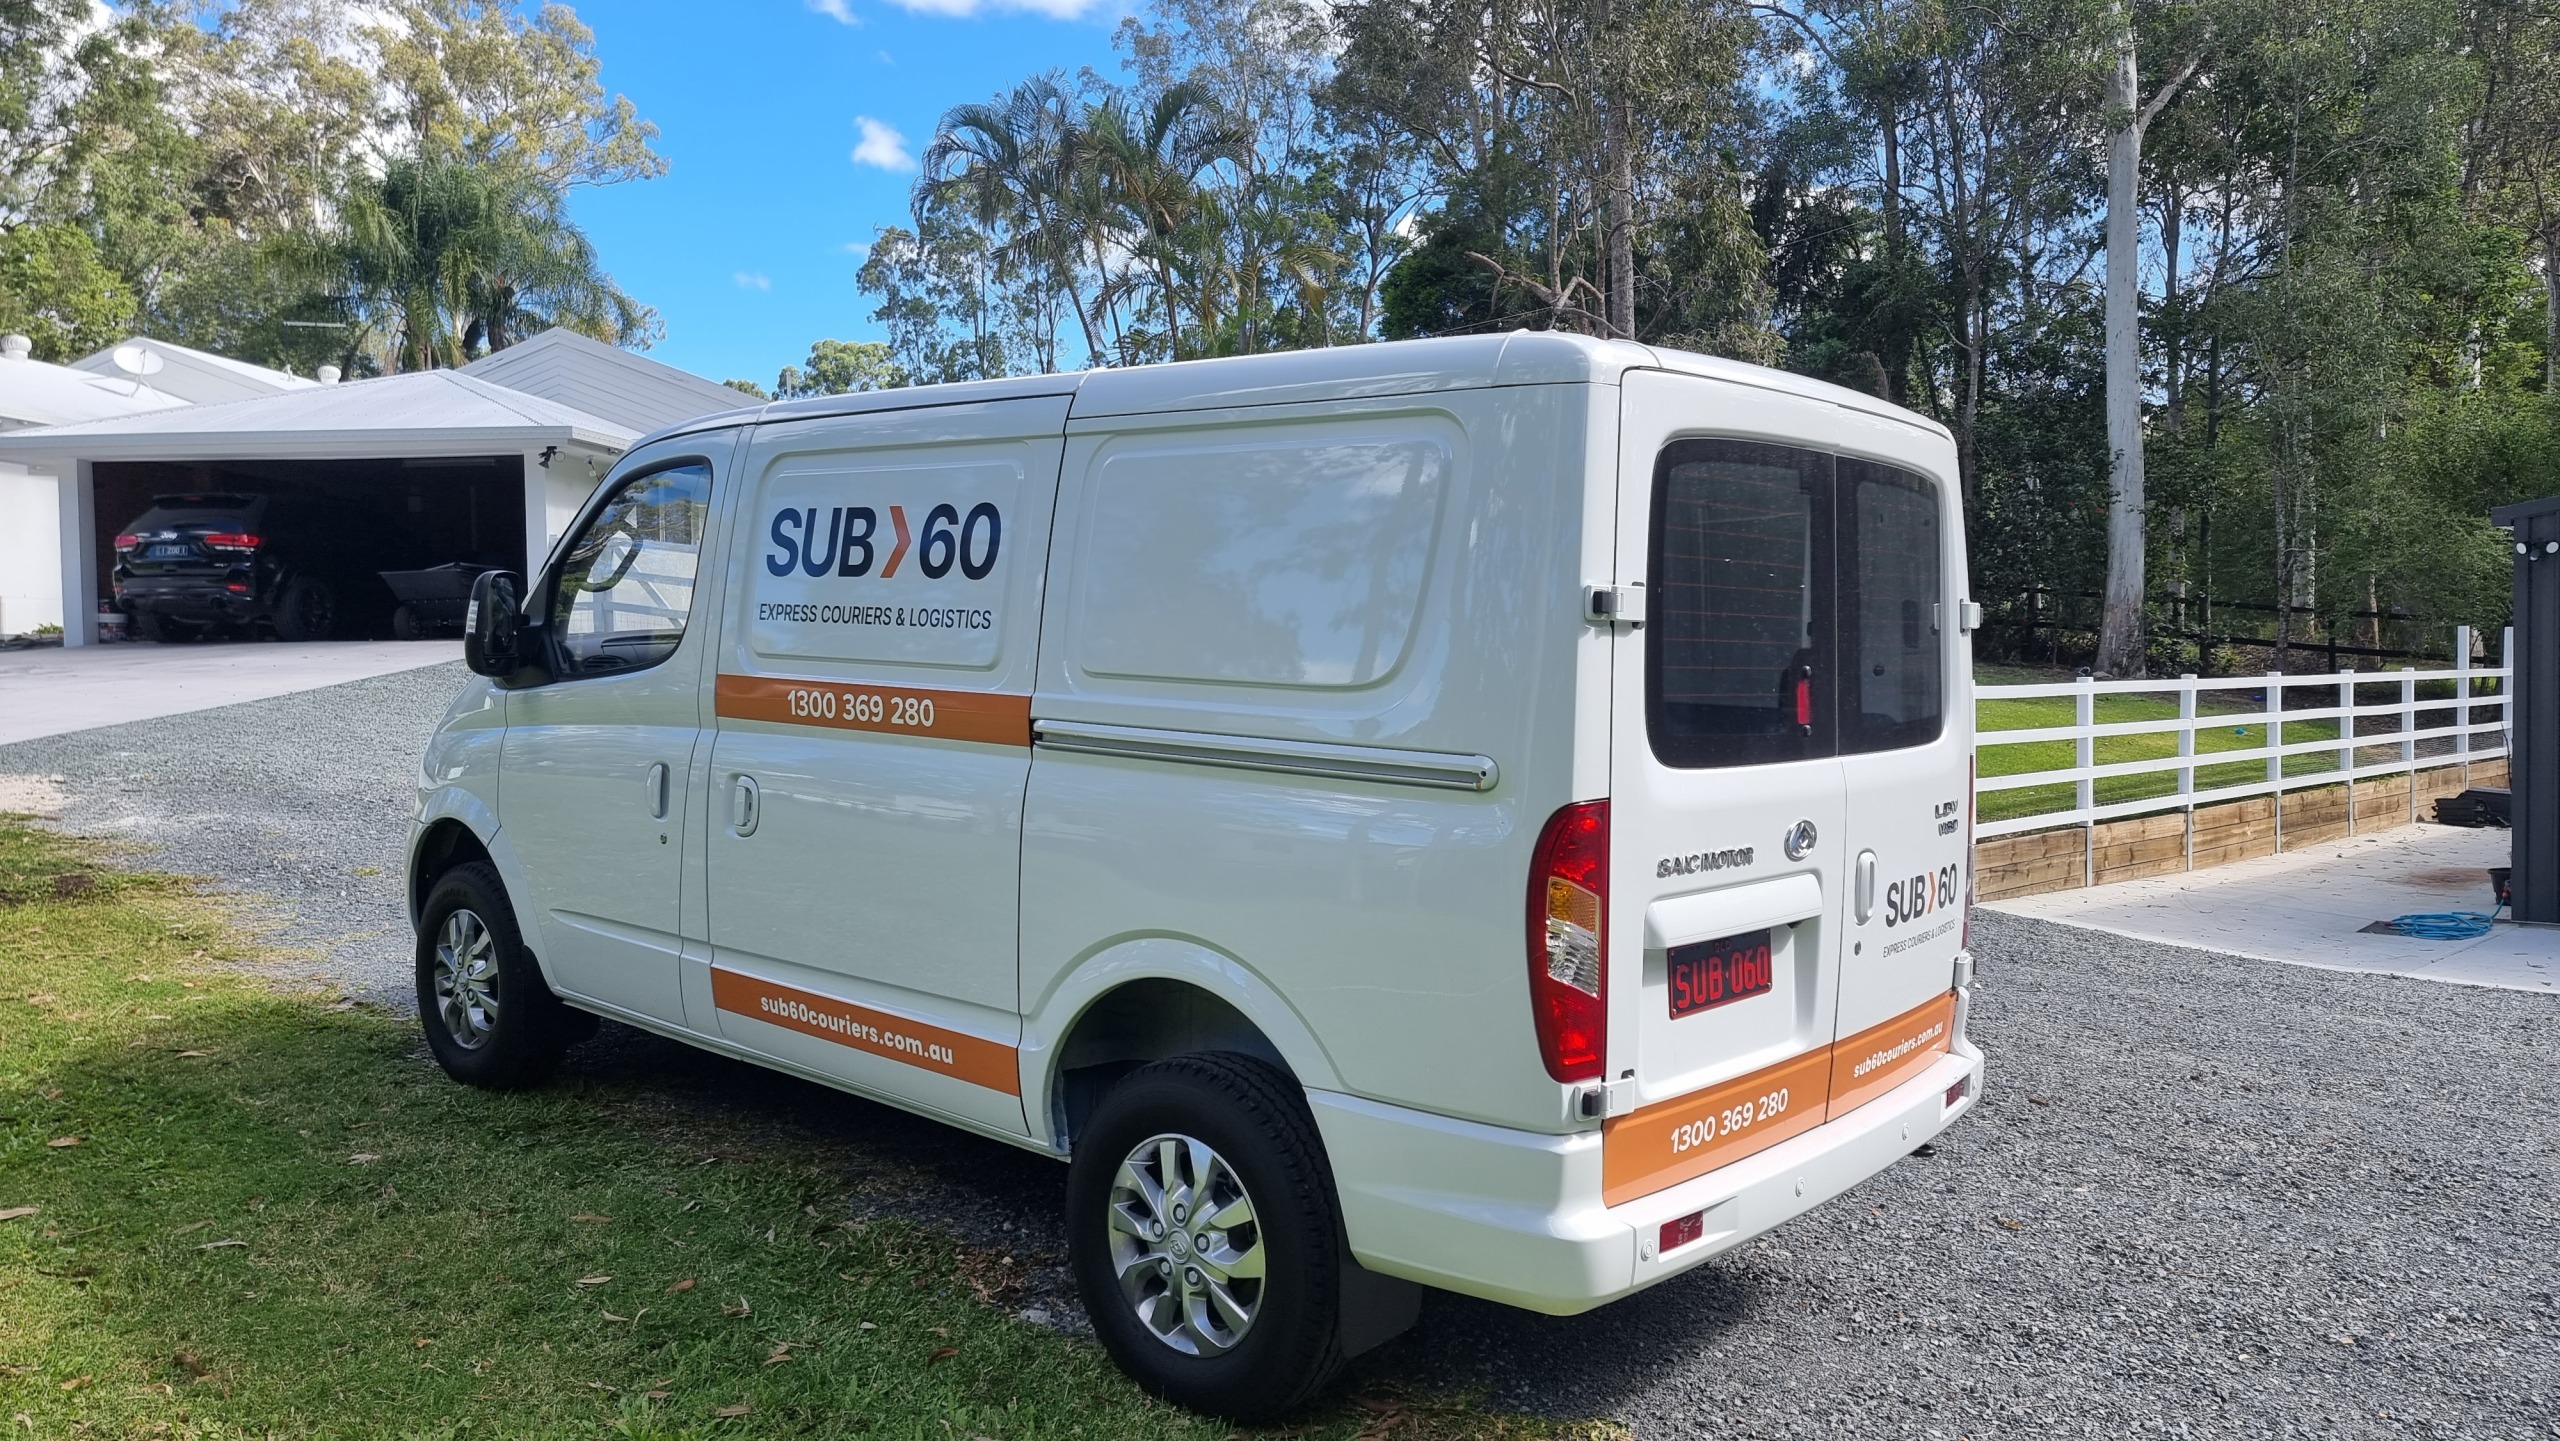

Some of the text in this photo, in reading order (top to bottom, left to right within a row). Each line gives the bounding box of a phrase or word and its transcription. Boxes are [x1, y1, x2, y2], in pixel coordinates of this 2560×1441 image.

[766, 502, 1002, 580] SUB 60
[759, 603, 992, 630] EXPRESS COURIERS & LOGISTICS
[787, 689, 935, 727] 1300 369 280
[1656, 847, 1754, 878] SAIC MOTOR
[1885, 863, 1958, 928] SUB 60
[1883, 939, 1907, 958] EXPRESS
[1907, 929, 1931, 949] COURIERS
[1934, 919, 1956, 938] LOGISTICS
[761, 996, 954, 1065] sub60couriers.com.au
[1853, 1020, 1943, 1079] sub60couriers.com.au
[1670, 1087, 1789, 1154] 1300 369 280
